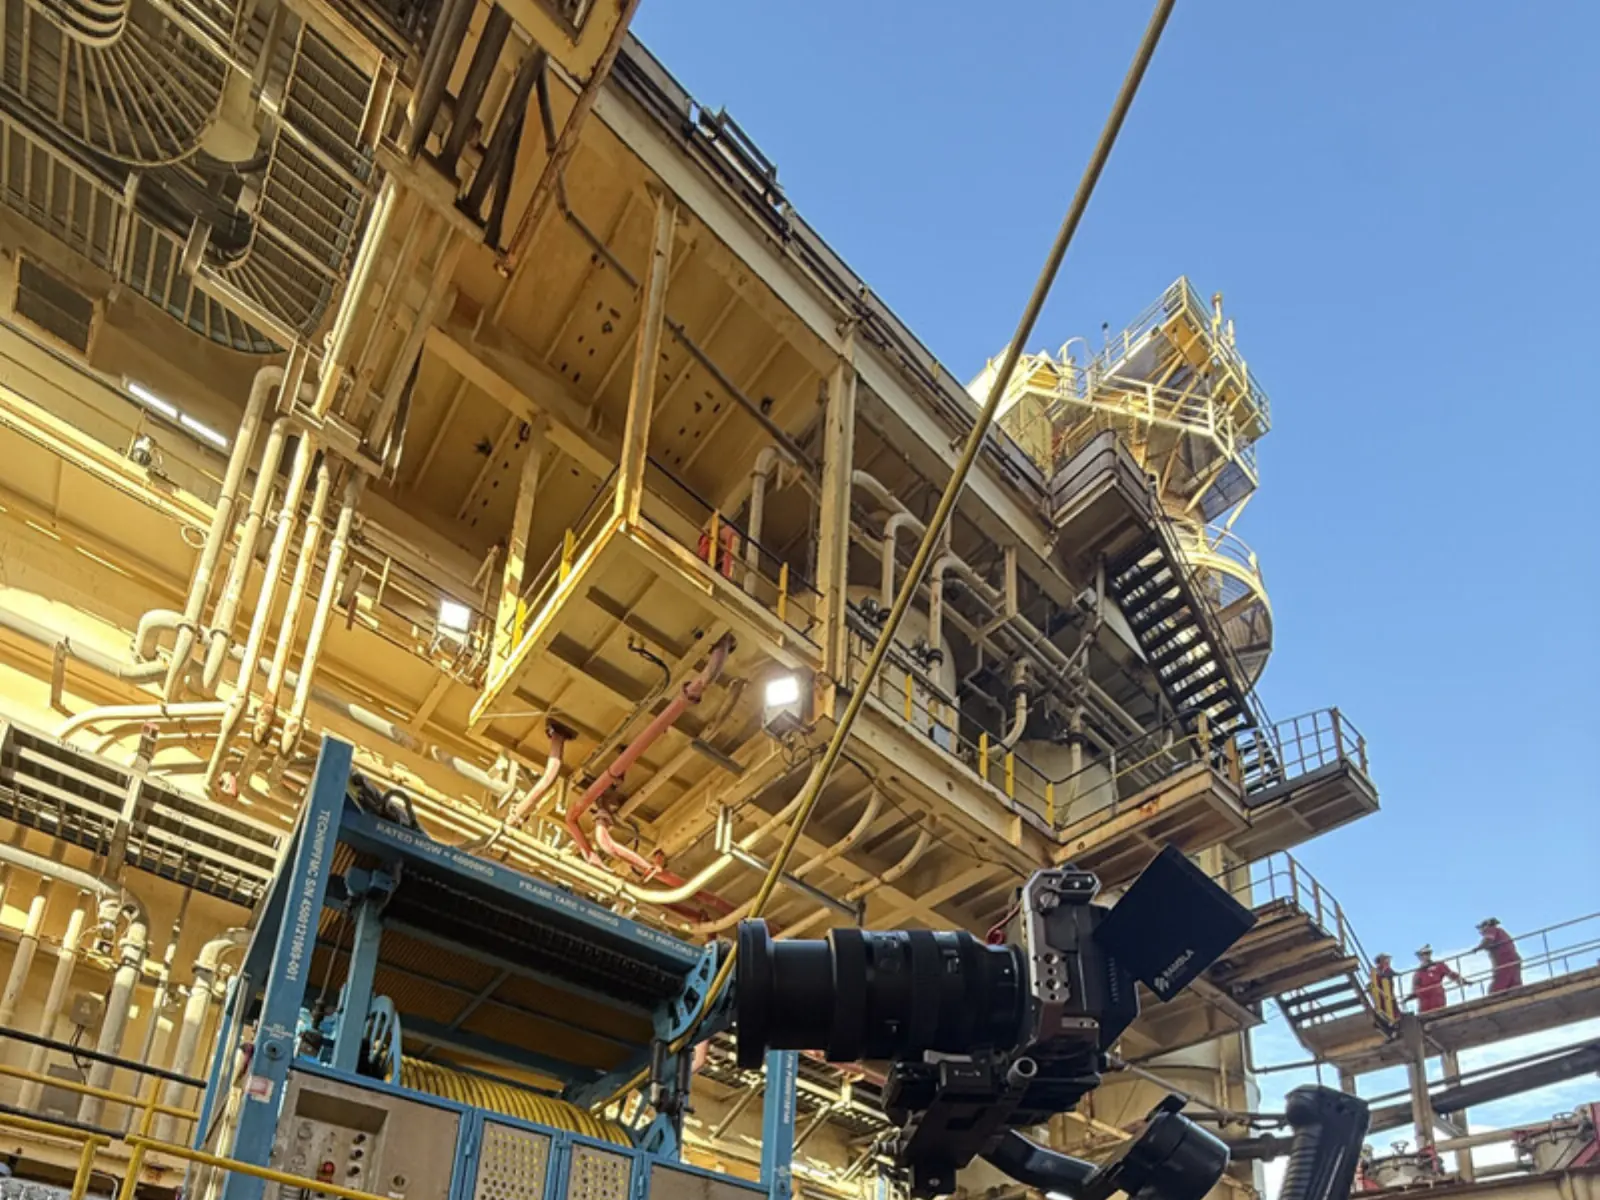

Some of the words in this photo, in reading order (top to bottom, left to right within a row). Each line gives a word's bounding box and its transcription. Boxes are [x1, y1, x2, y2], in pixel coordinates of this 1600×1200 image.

[306, 809, 331, 878] TECHNIPFMC
[376, 823, 413, 845] RATED
[518, 879, 553, 901] FRAME
